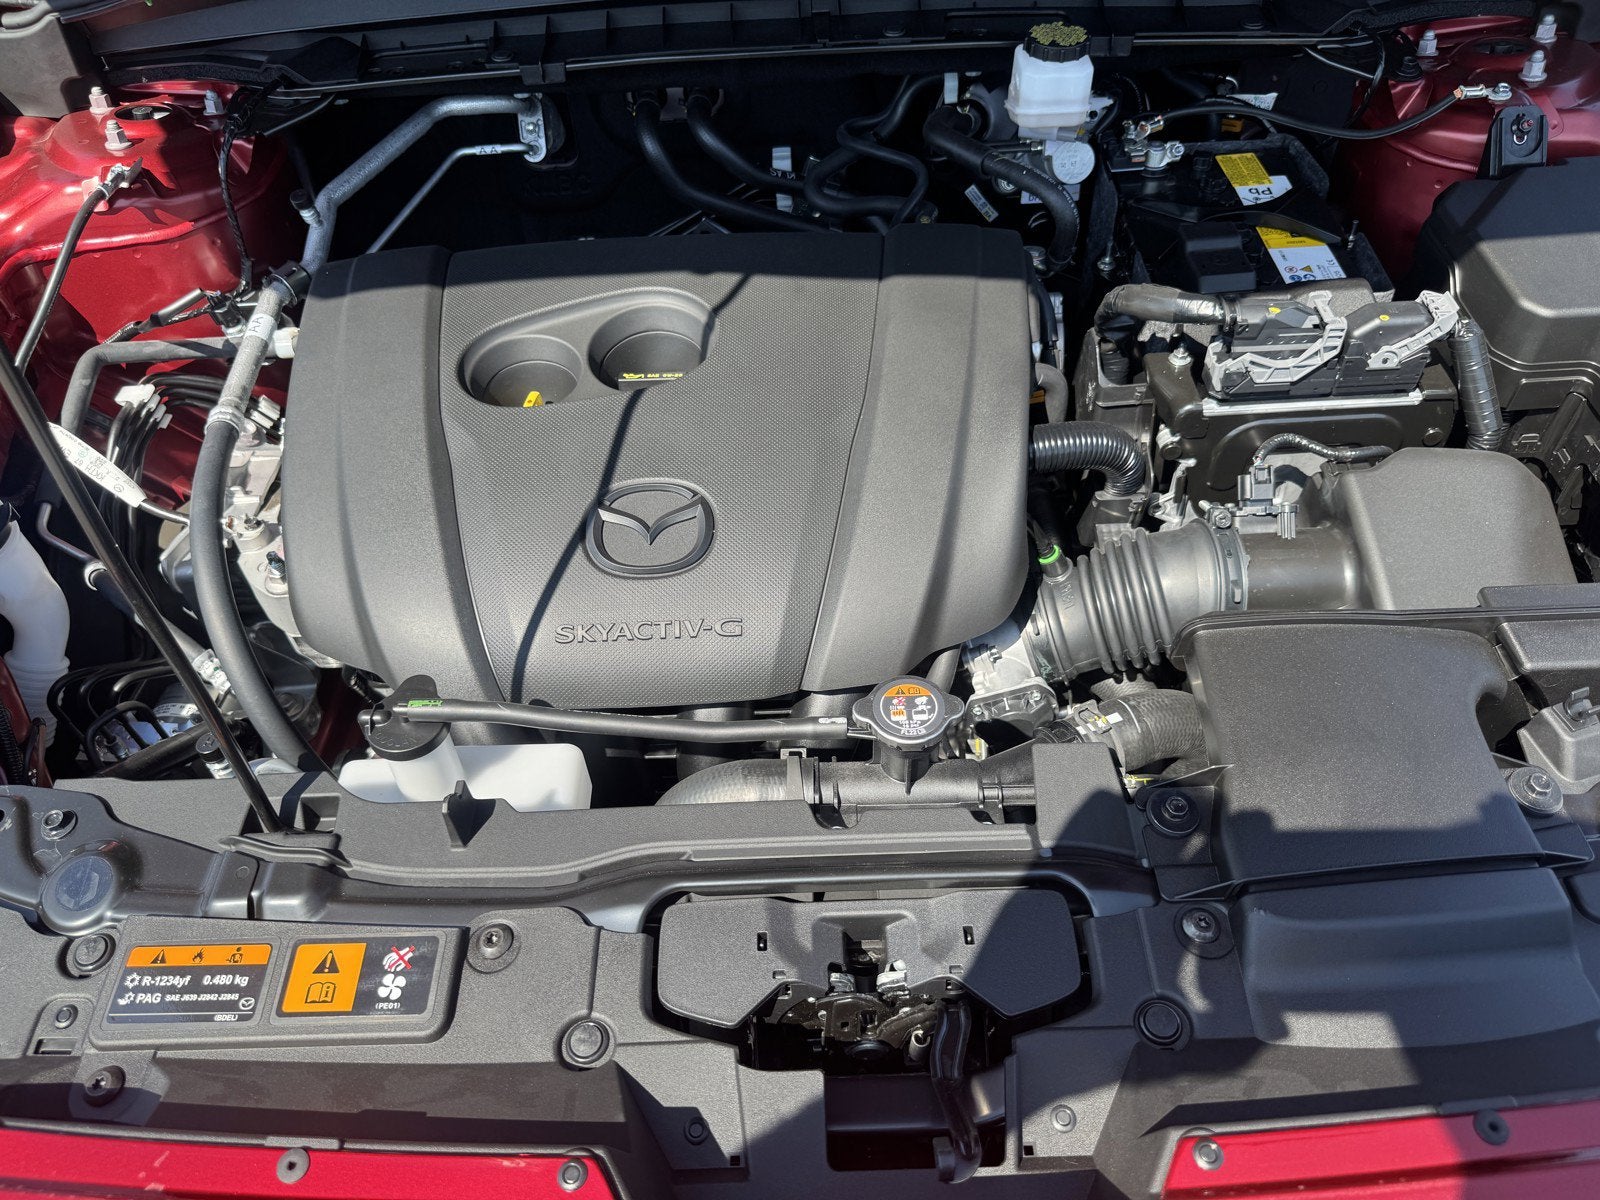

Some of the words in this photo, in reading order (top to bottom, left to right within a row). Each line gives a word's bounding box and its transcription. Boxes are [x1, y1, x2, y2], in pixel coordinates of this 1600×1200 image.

[1248, 187, 1274, 196] Pb
[554, 618, 743, 645] SKYACTIV-G
[141, 975, 192, 988] R-1234yf
[202, 975, 233, 986] 0.480
[233, 975, 250, 987] kg
[135, 993, 162, 1004] PAG
[164, 994, 181, 1002] SAE
[181, 994, 198, 1002] J639
[375, 1002, 401, 1010] (PE01)
